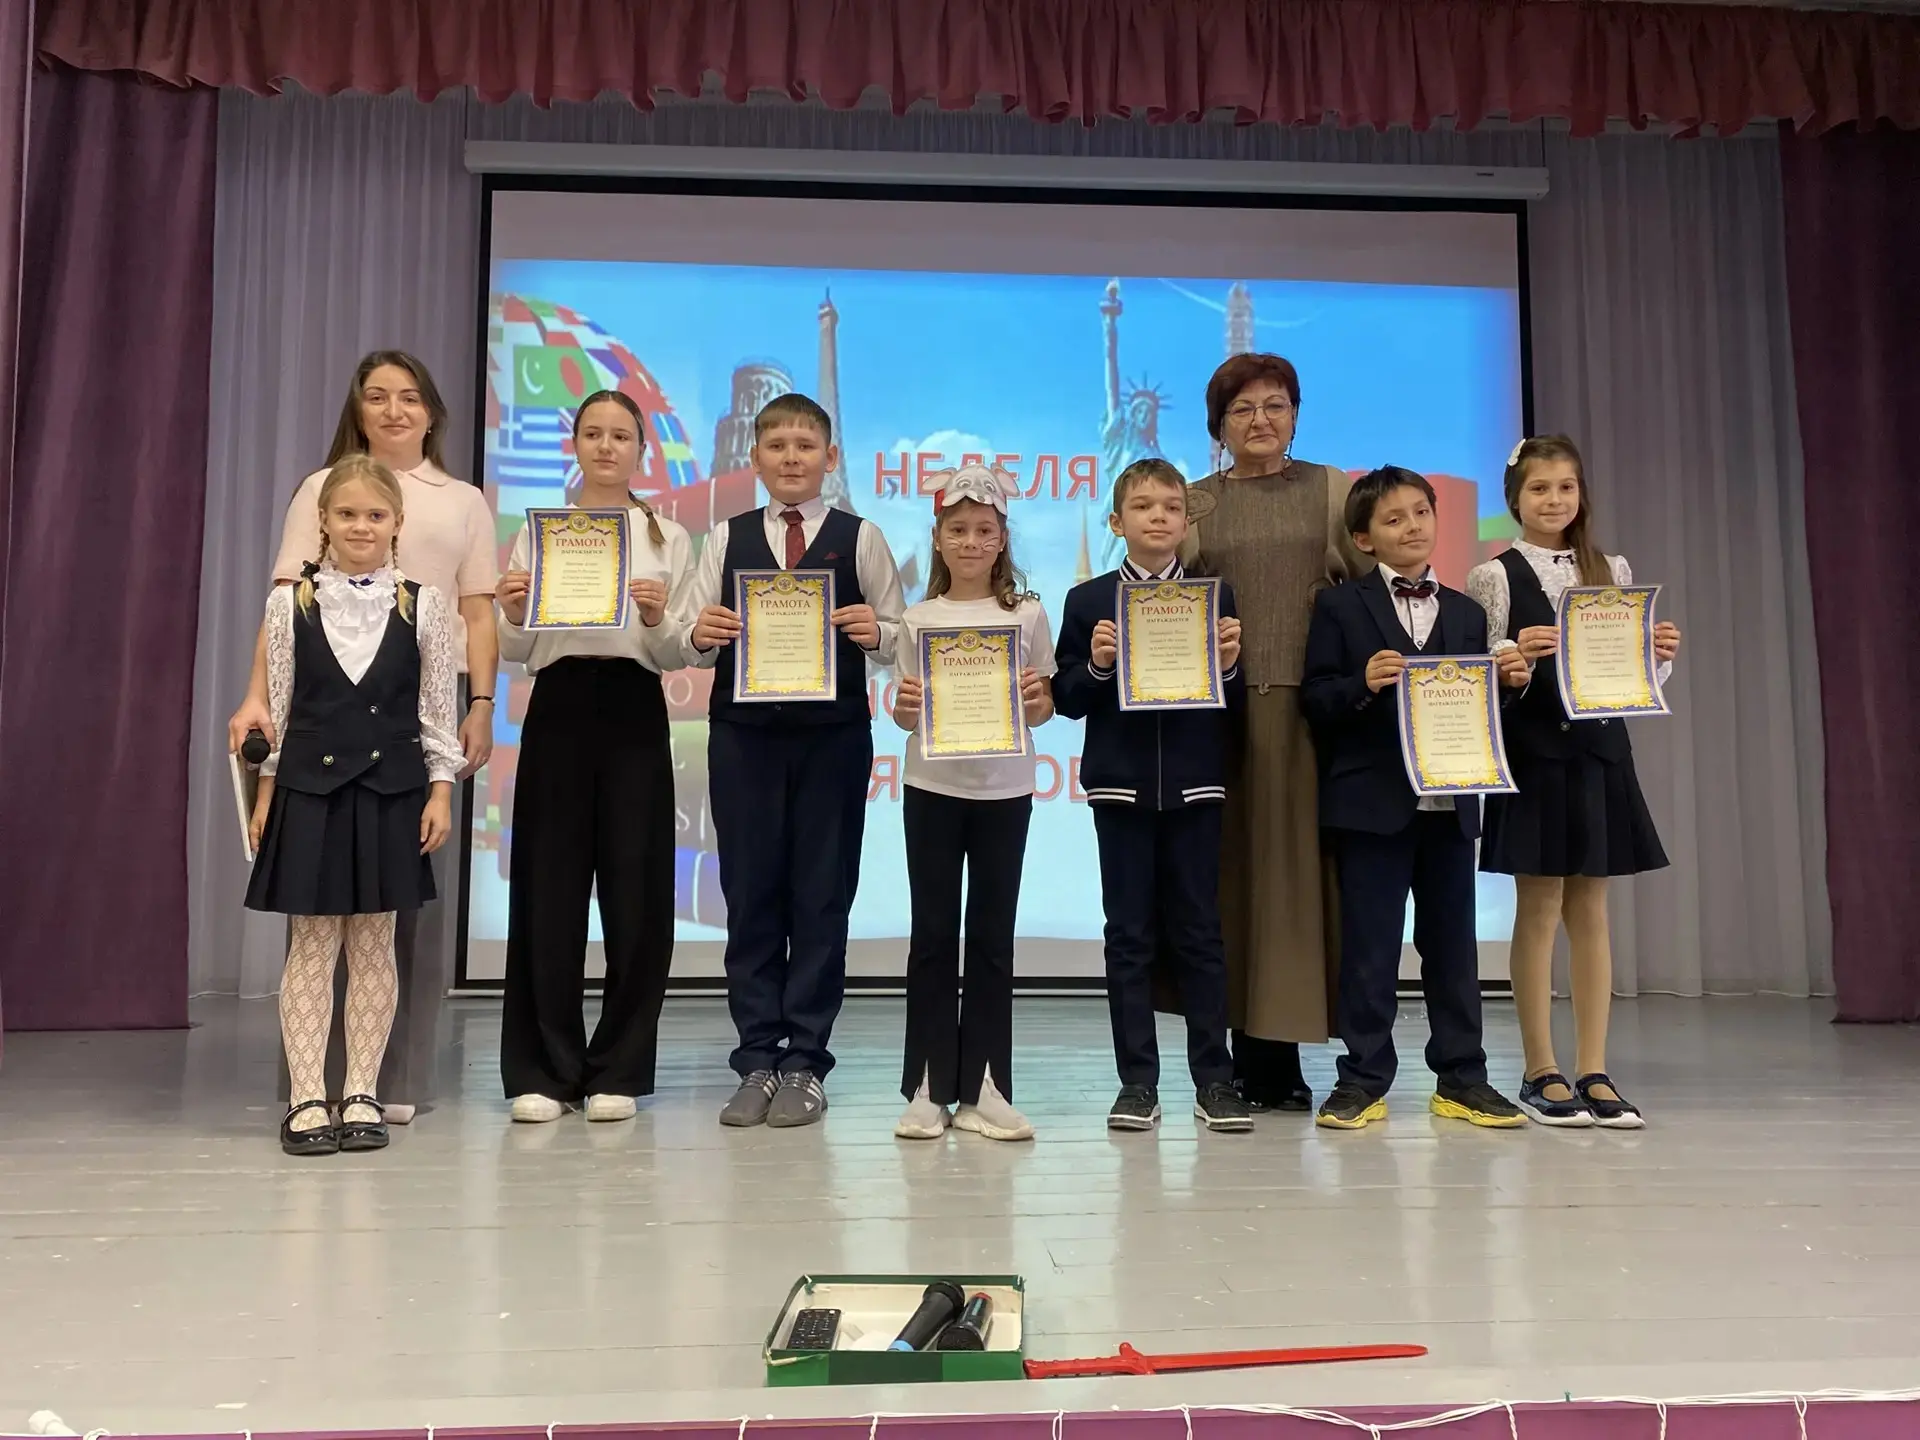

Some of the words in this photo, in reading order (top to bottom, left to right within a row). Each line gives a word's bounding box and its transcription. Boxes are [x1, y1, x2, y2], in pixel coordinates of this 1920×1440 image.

[874, 451, 1099, 499] НЕЕЛЯ
[555, 538, 606, 548] ГРАМОТА
[760, 599, 811, 609] ГРАМОТА
[1141, 605, 1193, 616] ГРАМОТА
[1580, 611, 1631, 622] ГРАМОТА
[943, 656, 996, 666] ГРАМОТА
[1423, 688, 1474, 698] ГРАМОТА
